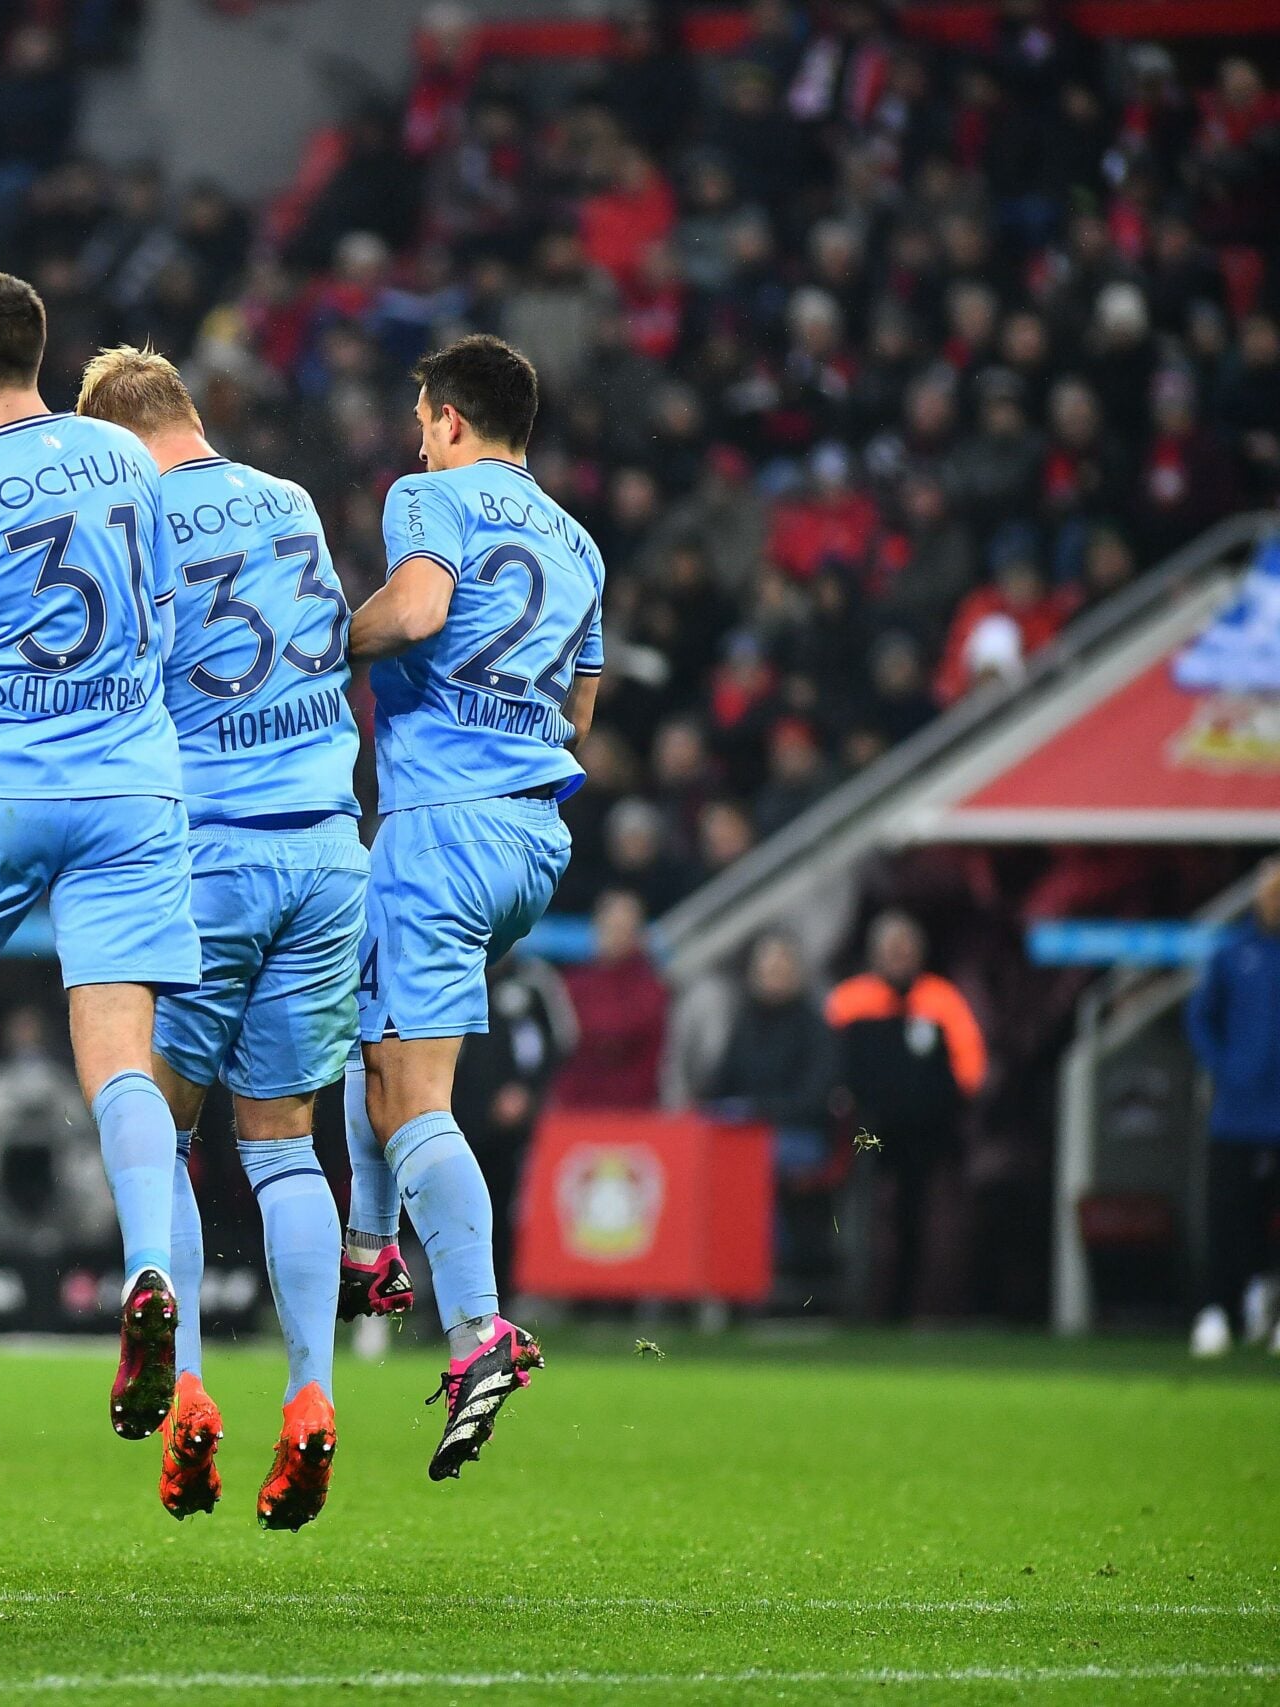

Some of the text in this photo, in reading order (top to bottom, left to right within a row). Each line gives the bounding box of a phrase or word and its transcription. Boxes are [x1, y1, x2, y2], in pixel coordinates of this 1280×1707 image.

[408, 498, 425, 546] VIACTIV
[4, 501, 151, 673] 31
[181, 533, 348, 700] 33
[219, 687, 341, 752] HOFMANN
[359, 935, 379, 1000] 4
